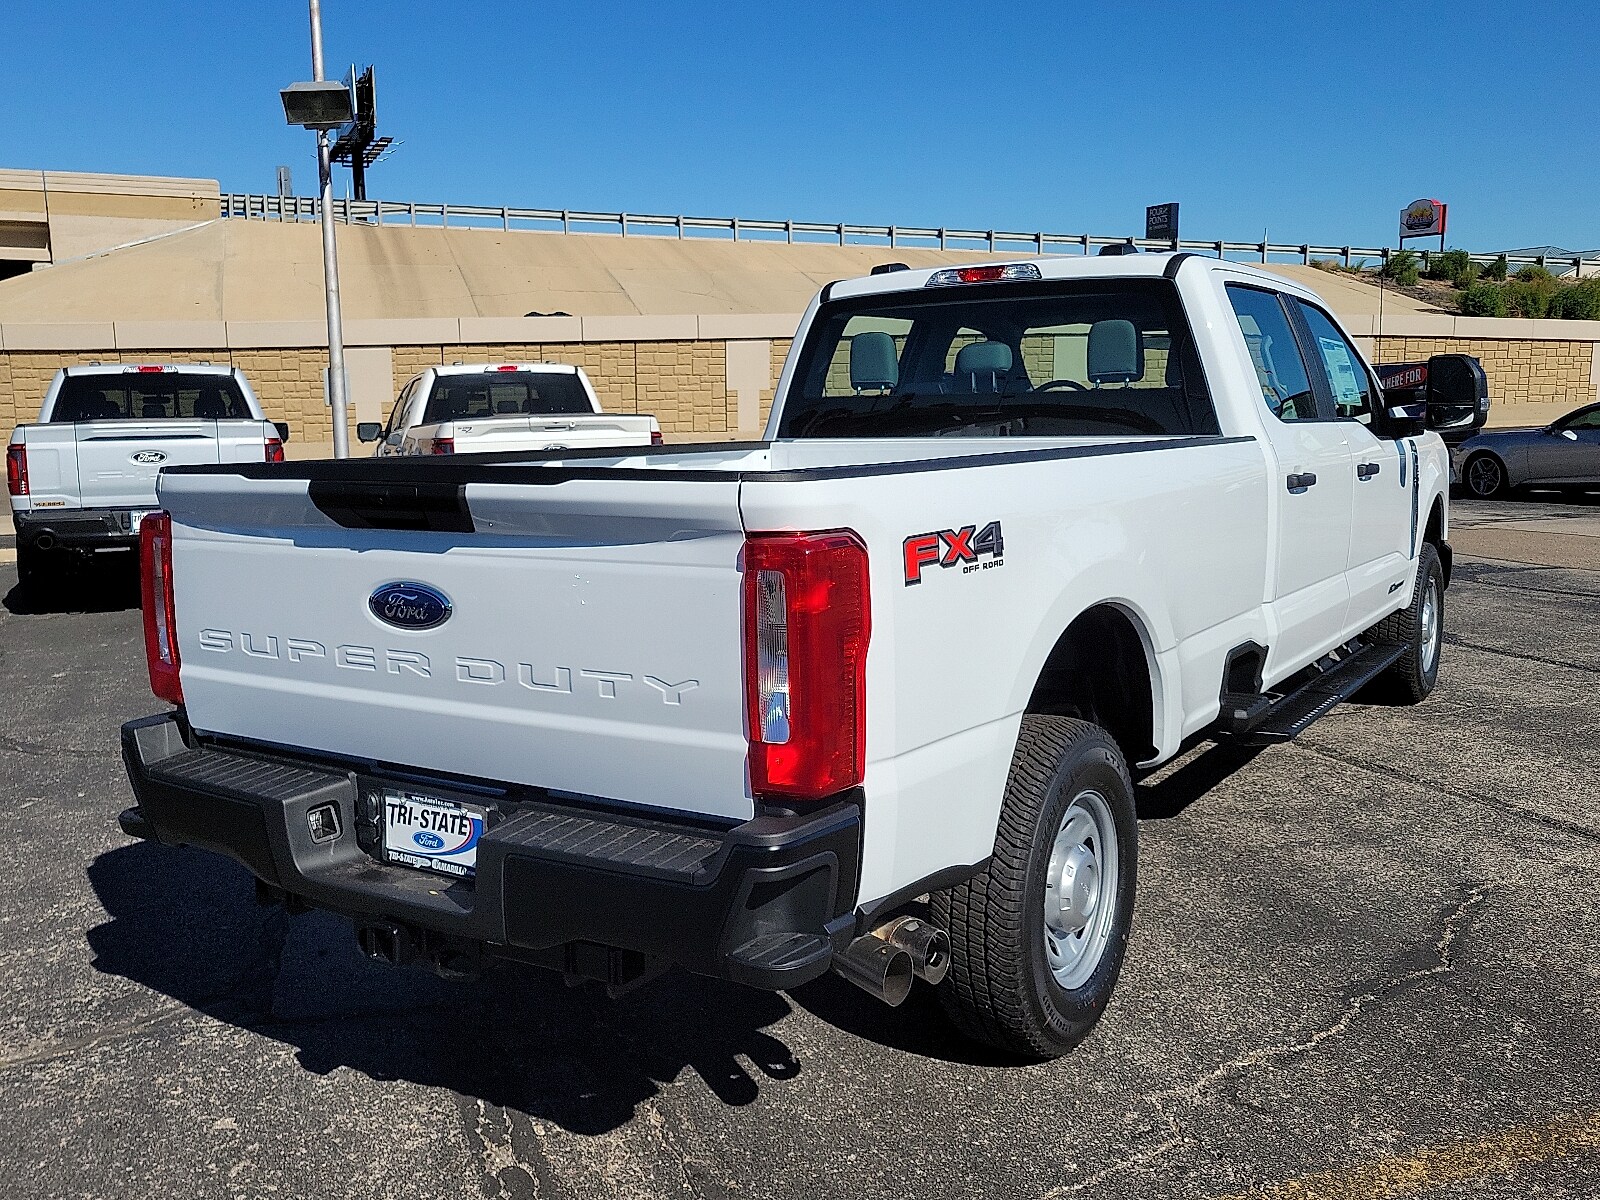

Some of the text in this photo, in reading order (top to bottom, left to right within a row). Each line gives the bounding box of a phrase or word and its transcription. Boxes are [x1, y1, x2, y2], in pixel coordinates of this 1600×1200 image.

[1386, 368, 1422, 389] HERE FOR
[902, 520, 1004, 587] FX4
[963, 559, 1004, 574] OFF ROAD
[199, 628, 699, 706] SUPER DUTY
[387, 802, 470, 836] TRI-STATE
[418, 833, 439, 848] Ford
